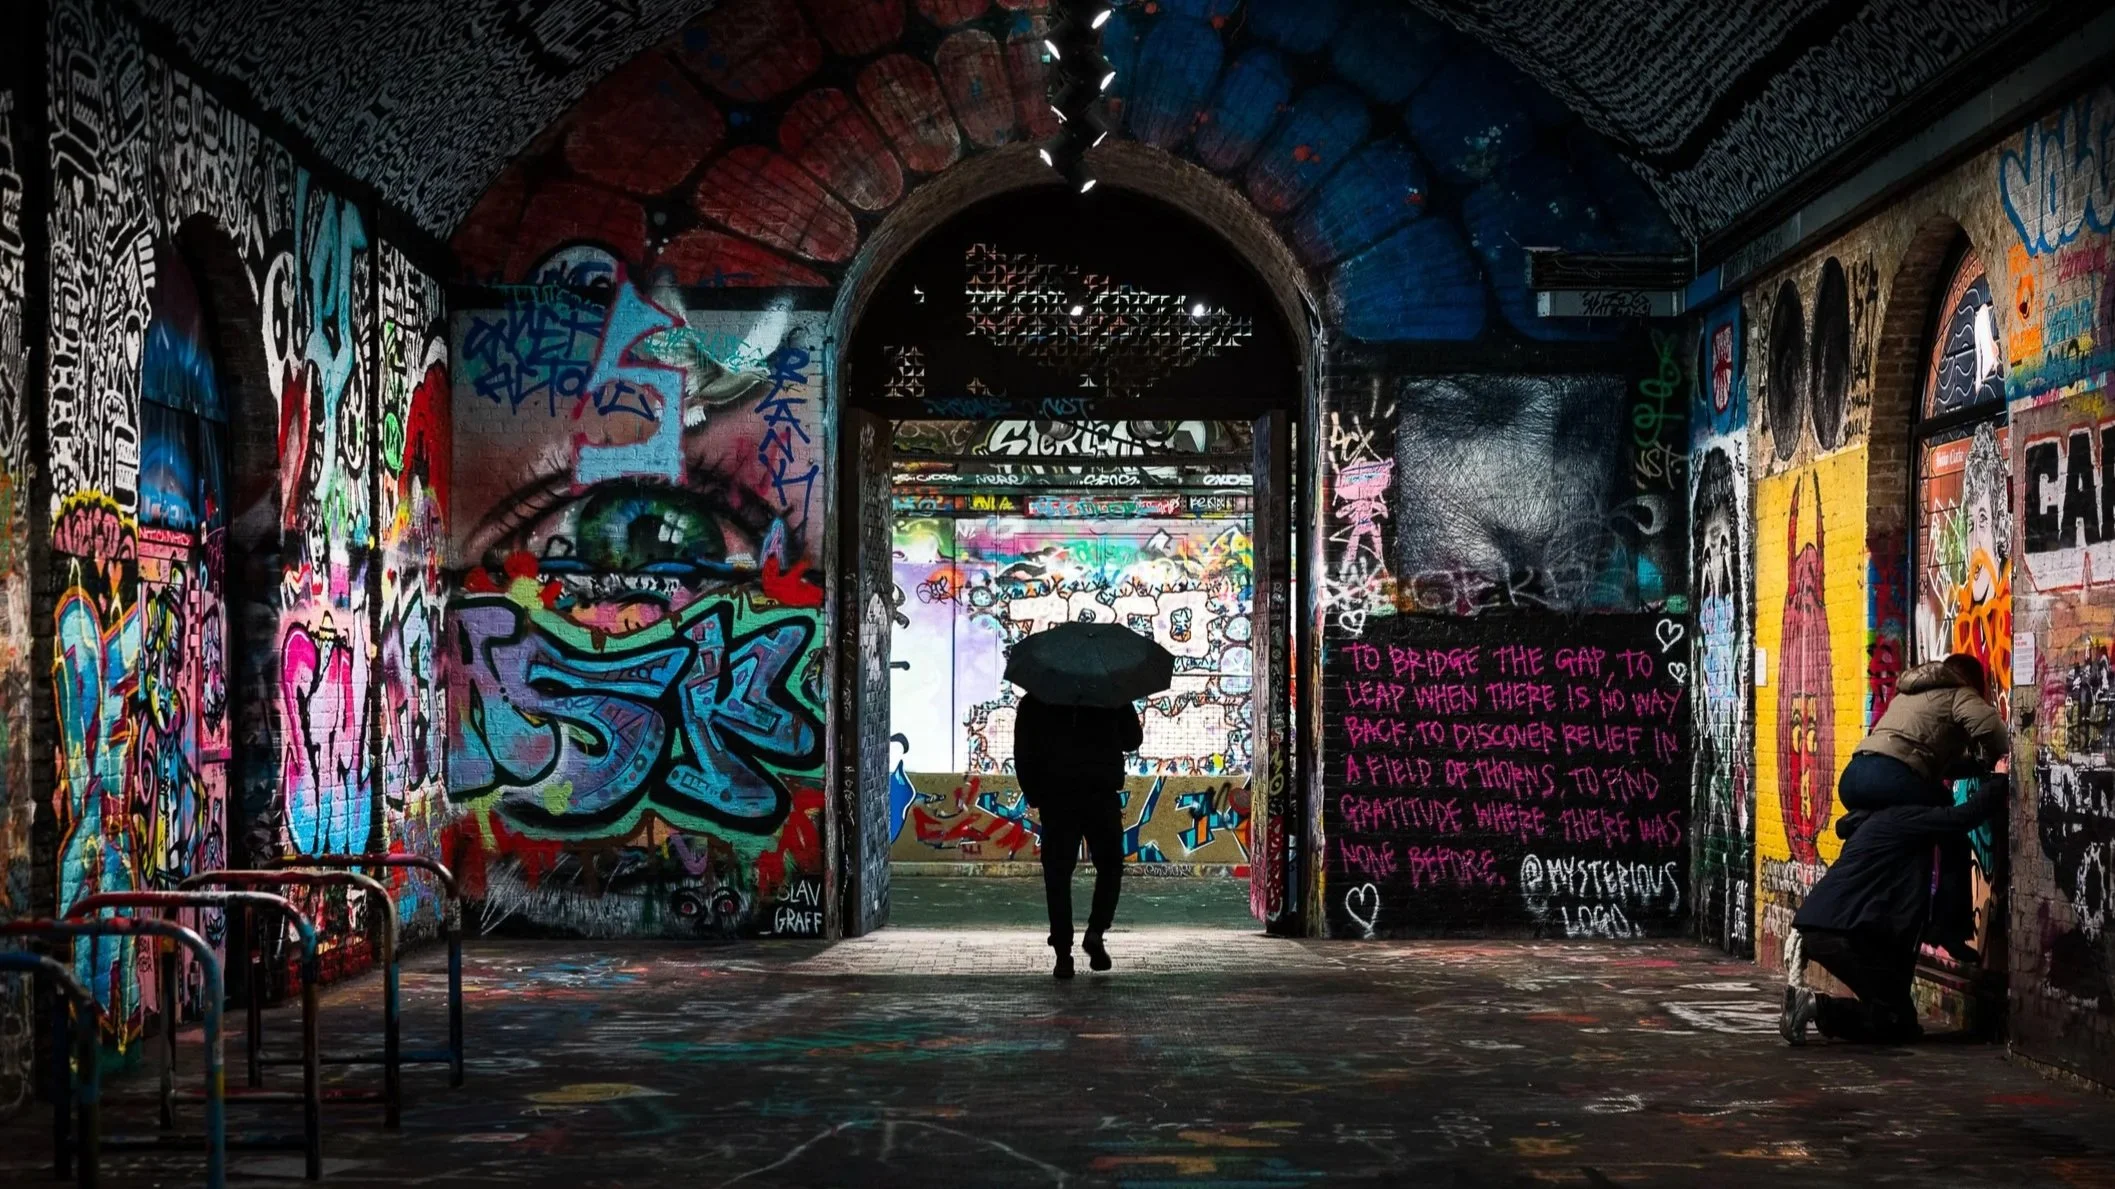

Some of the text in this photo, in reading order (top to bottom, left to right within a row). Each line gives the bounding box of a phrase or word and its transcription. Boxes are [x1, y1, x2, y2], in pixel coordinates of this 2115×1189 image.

[2025, 427, 2115, 553] CA
[1341, 642, 1380, 672] TO
[1388, 644, 1480, 683] BRIDGE
[1492, 644, 1545, 677] THE
[1616, 648, 1654, 680] TO
[1345, 680, 1683, 726] LEAP WHEN THERE IS NO WAY
[1416, 720, 1445, 746] TO
[1453, 720, 1557, 755] DISCOVER
[1561, 721, 1643, 755] RELIEF
[1654, 727, 1679, 764] IN
[1346, 754, 1361, 784] A
[1366, 754, 1432, 788] FIELD
[1445, 758, 1469, 790] OF
[1564, 765, 1600, 797] TO
[1602, 764, 1660, 804] FIND
[1340, 793, 1682, 848] GRATITUDE WHERE THERE WAS
[1340, 832, 1398, 884] NONE
[1520, 853, 1681, 912] @MYSTERIOUS
